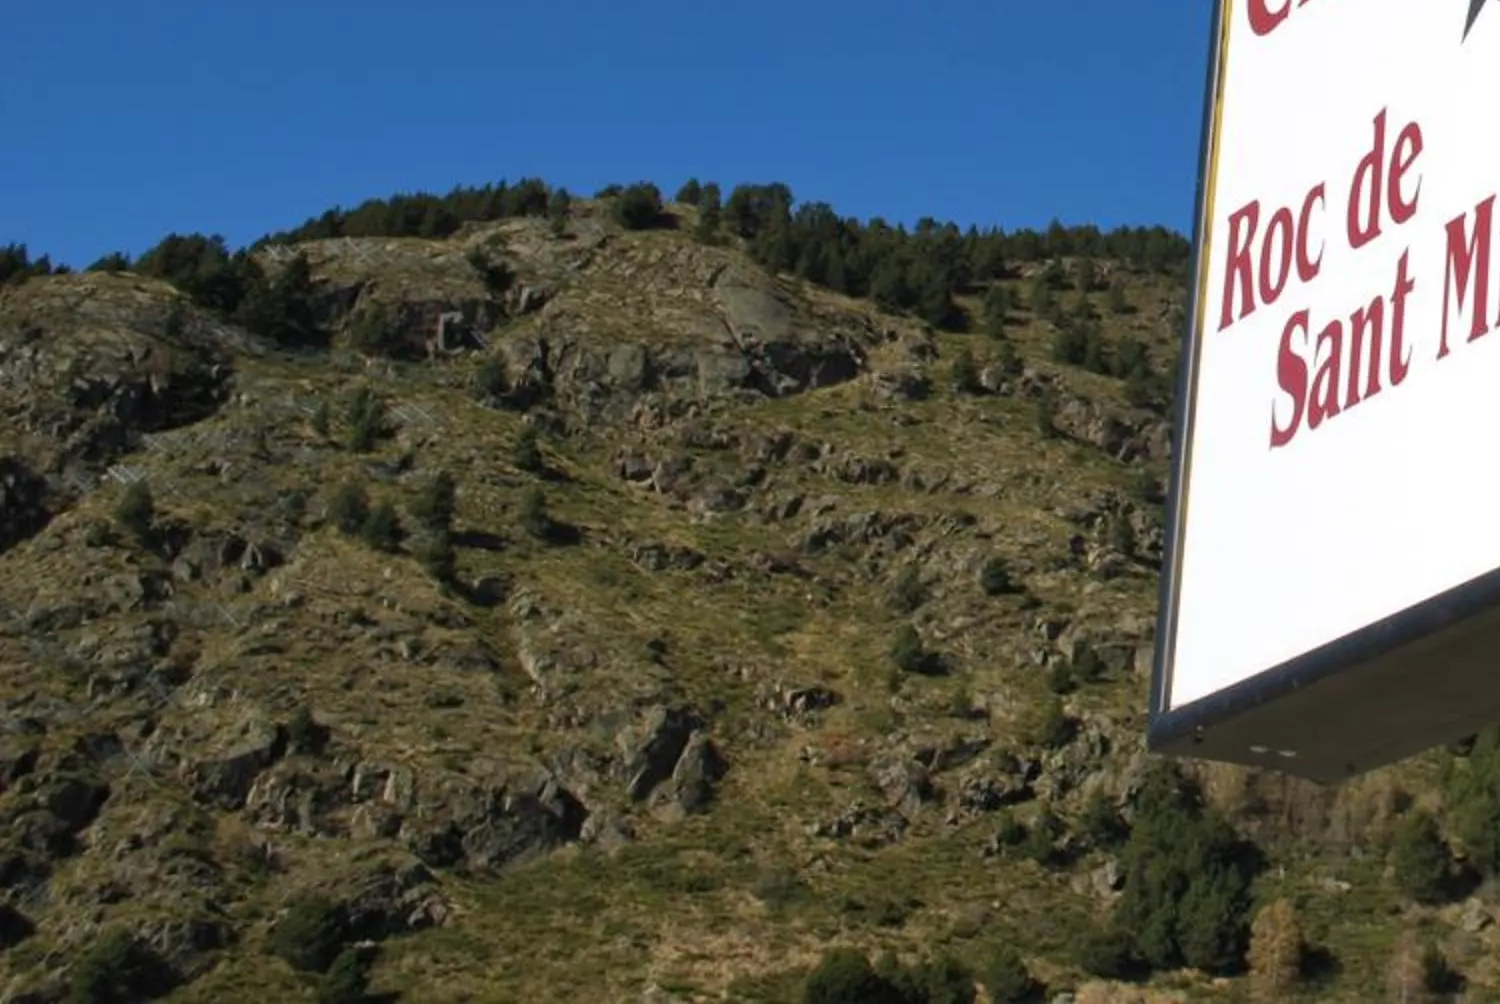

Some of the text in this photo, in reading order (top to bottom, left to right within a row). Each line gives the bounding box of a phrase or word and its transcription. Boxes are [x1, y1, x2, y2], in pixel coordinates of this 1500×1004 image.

[1219, 108, 1423, 330] Roc de
[1269, 250, 1414, 448] Sant
